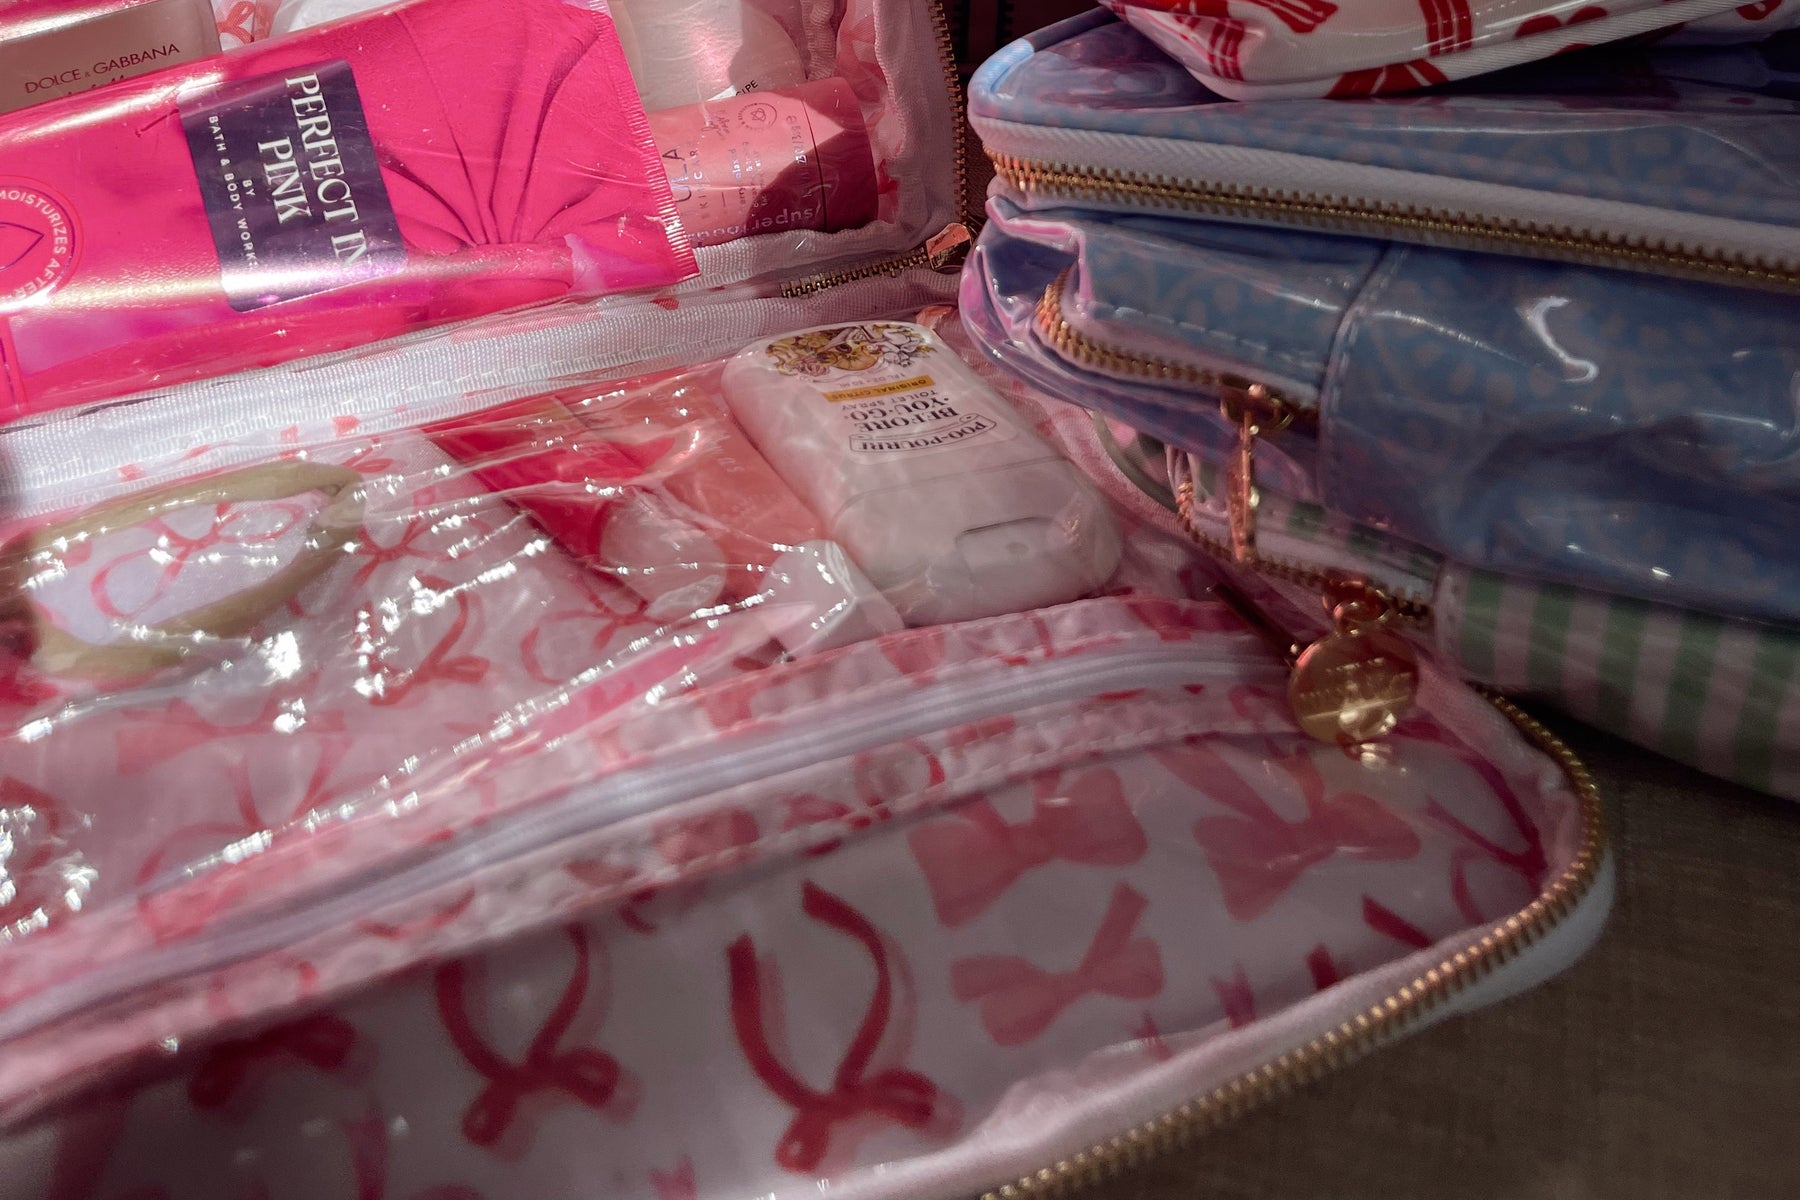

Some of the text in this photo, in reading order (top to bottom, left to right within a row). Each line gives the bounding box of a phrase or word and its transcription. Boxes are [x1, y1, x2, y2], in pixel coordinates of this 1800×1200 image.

[24, 68, 81, 94] DOLCE
[93, 43, 180, 74] GABBANA
[208, 115, 227, 152] BATH
[220, 157, 231, 168] &
[257, 136, 312, 224] PINK
[285, 72, 368, 268] PERFECT IN
[224, 172, 244, 212] BODY
[241, 179, 256, 197] BY
[14, 257, 61, 299] AFTER
[831, 379, 927, 400] ORIGINAL CITRUS
[842, 389, 938, 412] TOILET SPRAY
[854, 406, 959, 433] BEFORE
